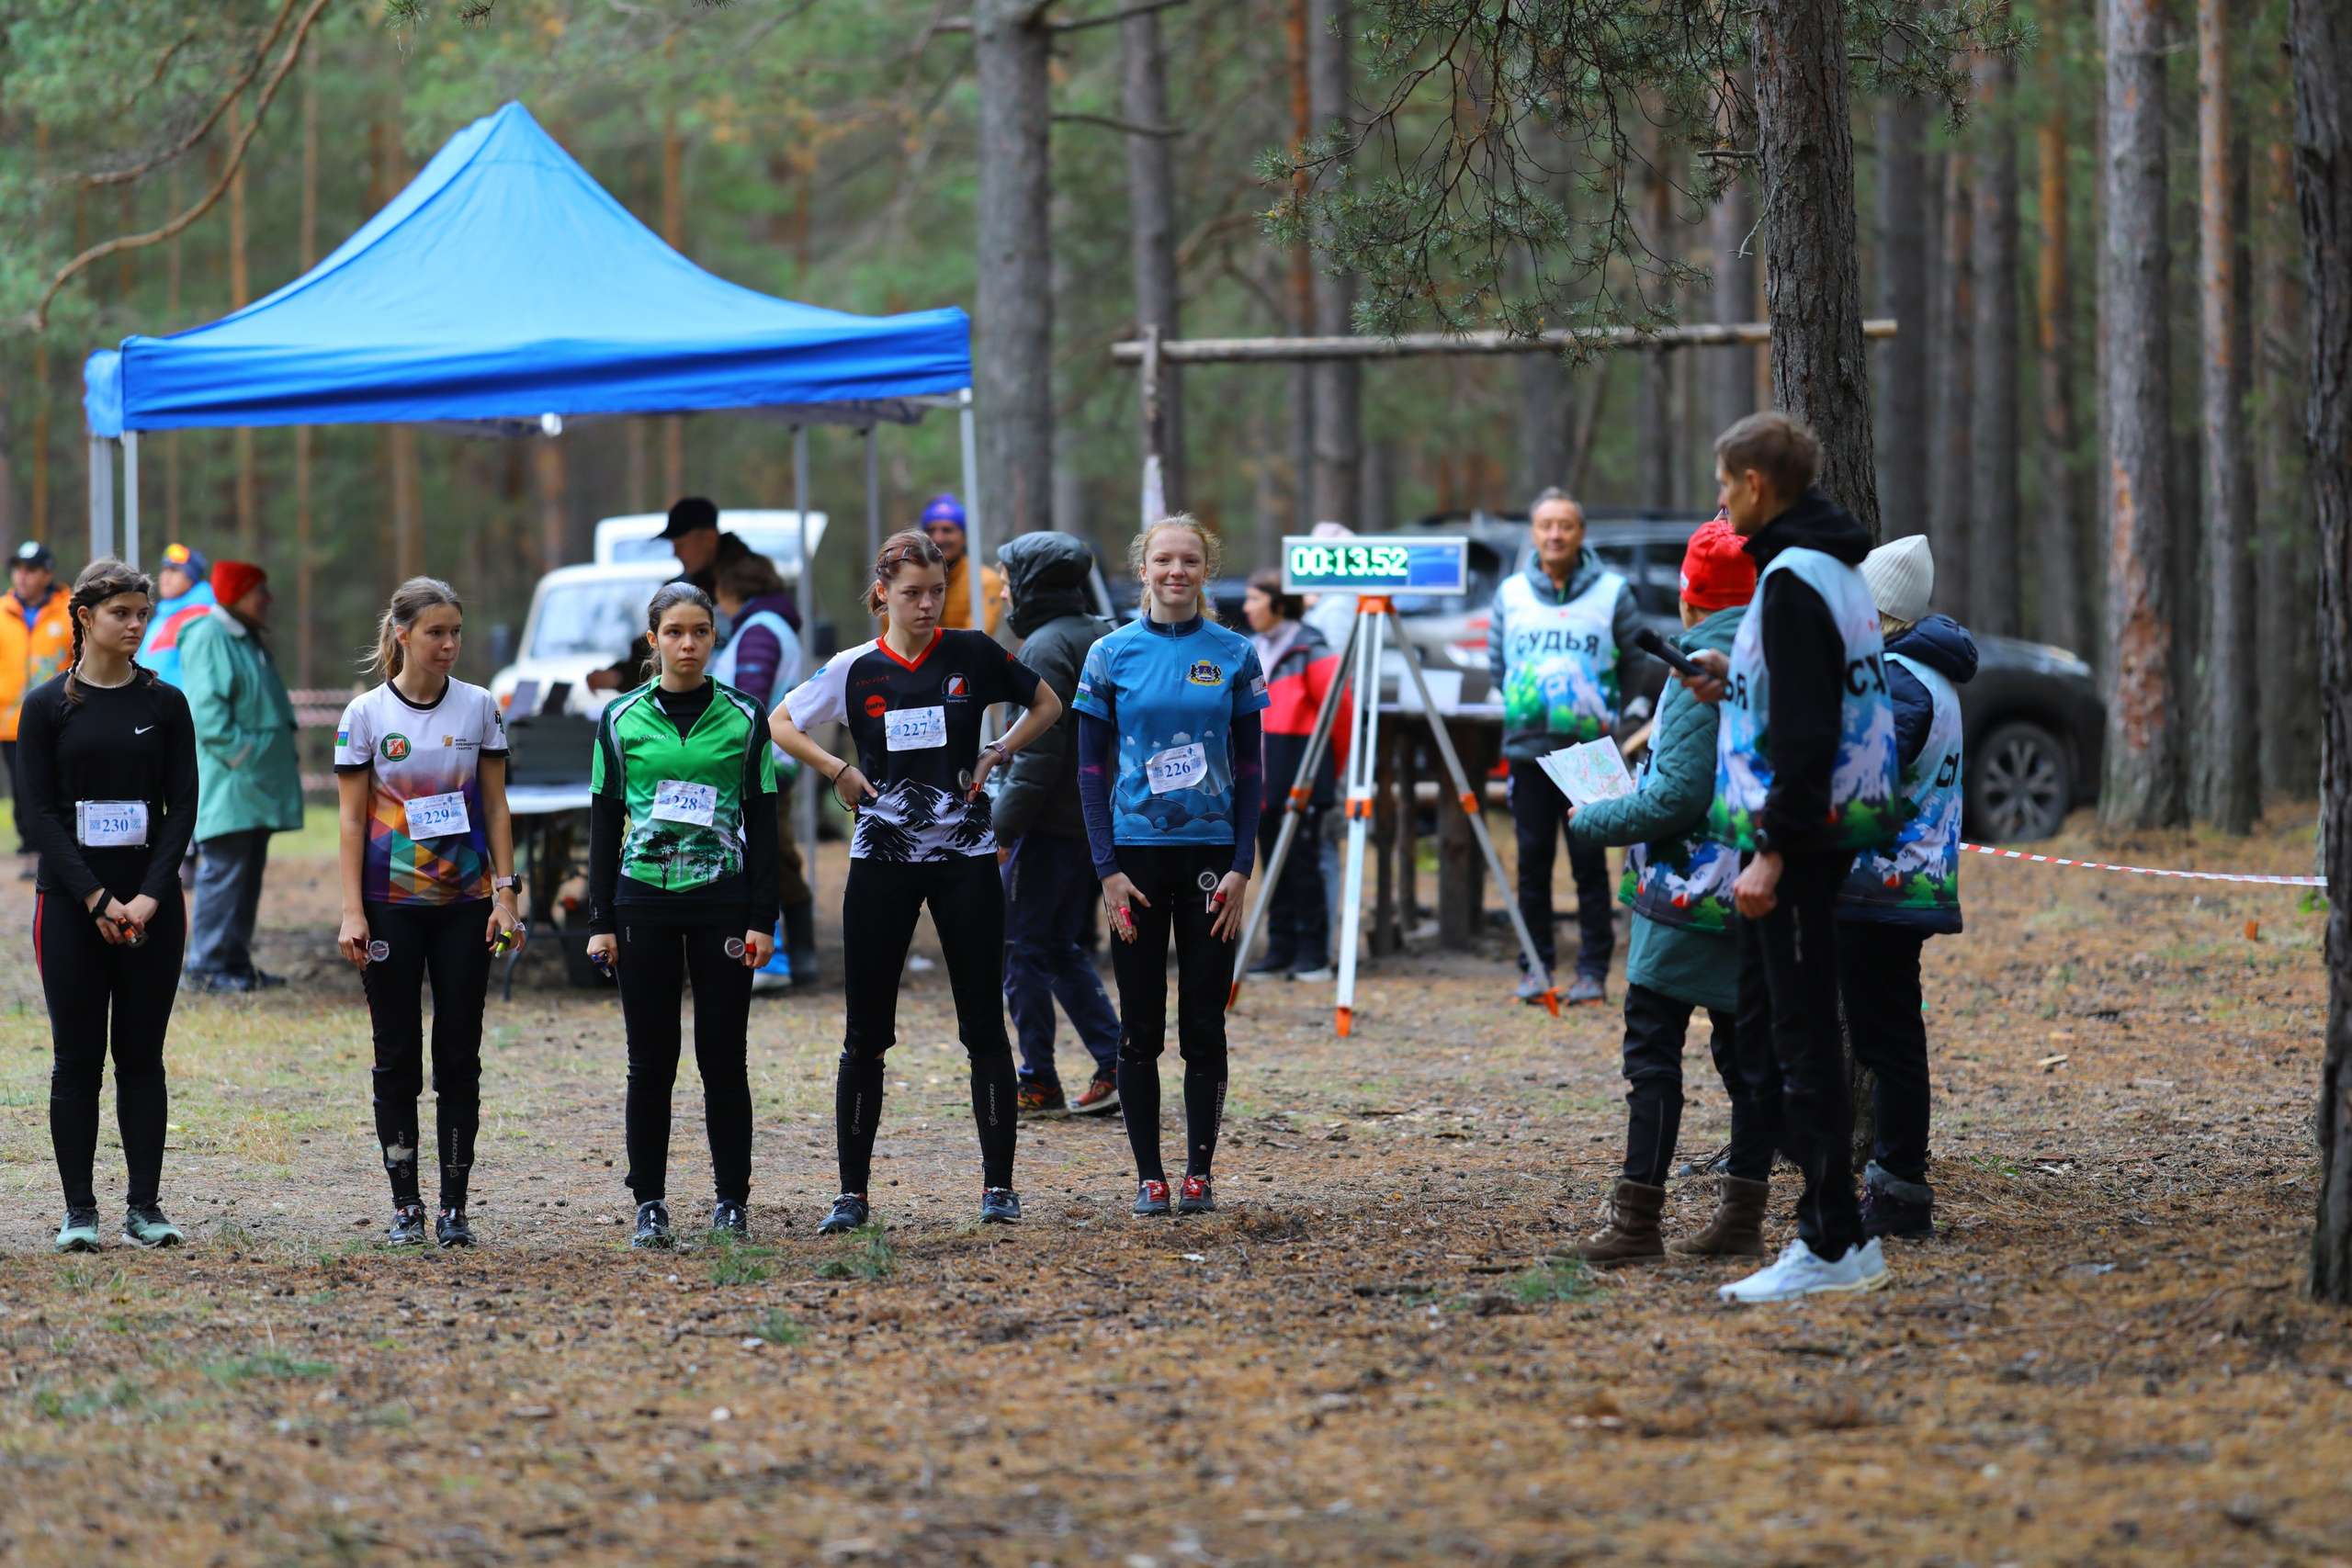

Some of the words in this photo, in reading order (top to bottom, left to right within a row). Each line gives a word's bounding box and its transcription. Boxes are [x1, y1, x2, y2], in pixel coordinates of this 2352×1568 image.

[1517, 630, 1600, 657] СУДЬЯ
[902, 722, 928, 737] 227
[1164, 760, 1191, 778] 226
[672, 795, 697, 811] 228
[424, 808, 449, 825] 229
[102, 818, 129, 832] 230
